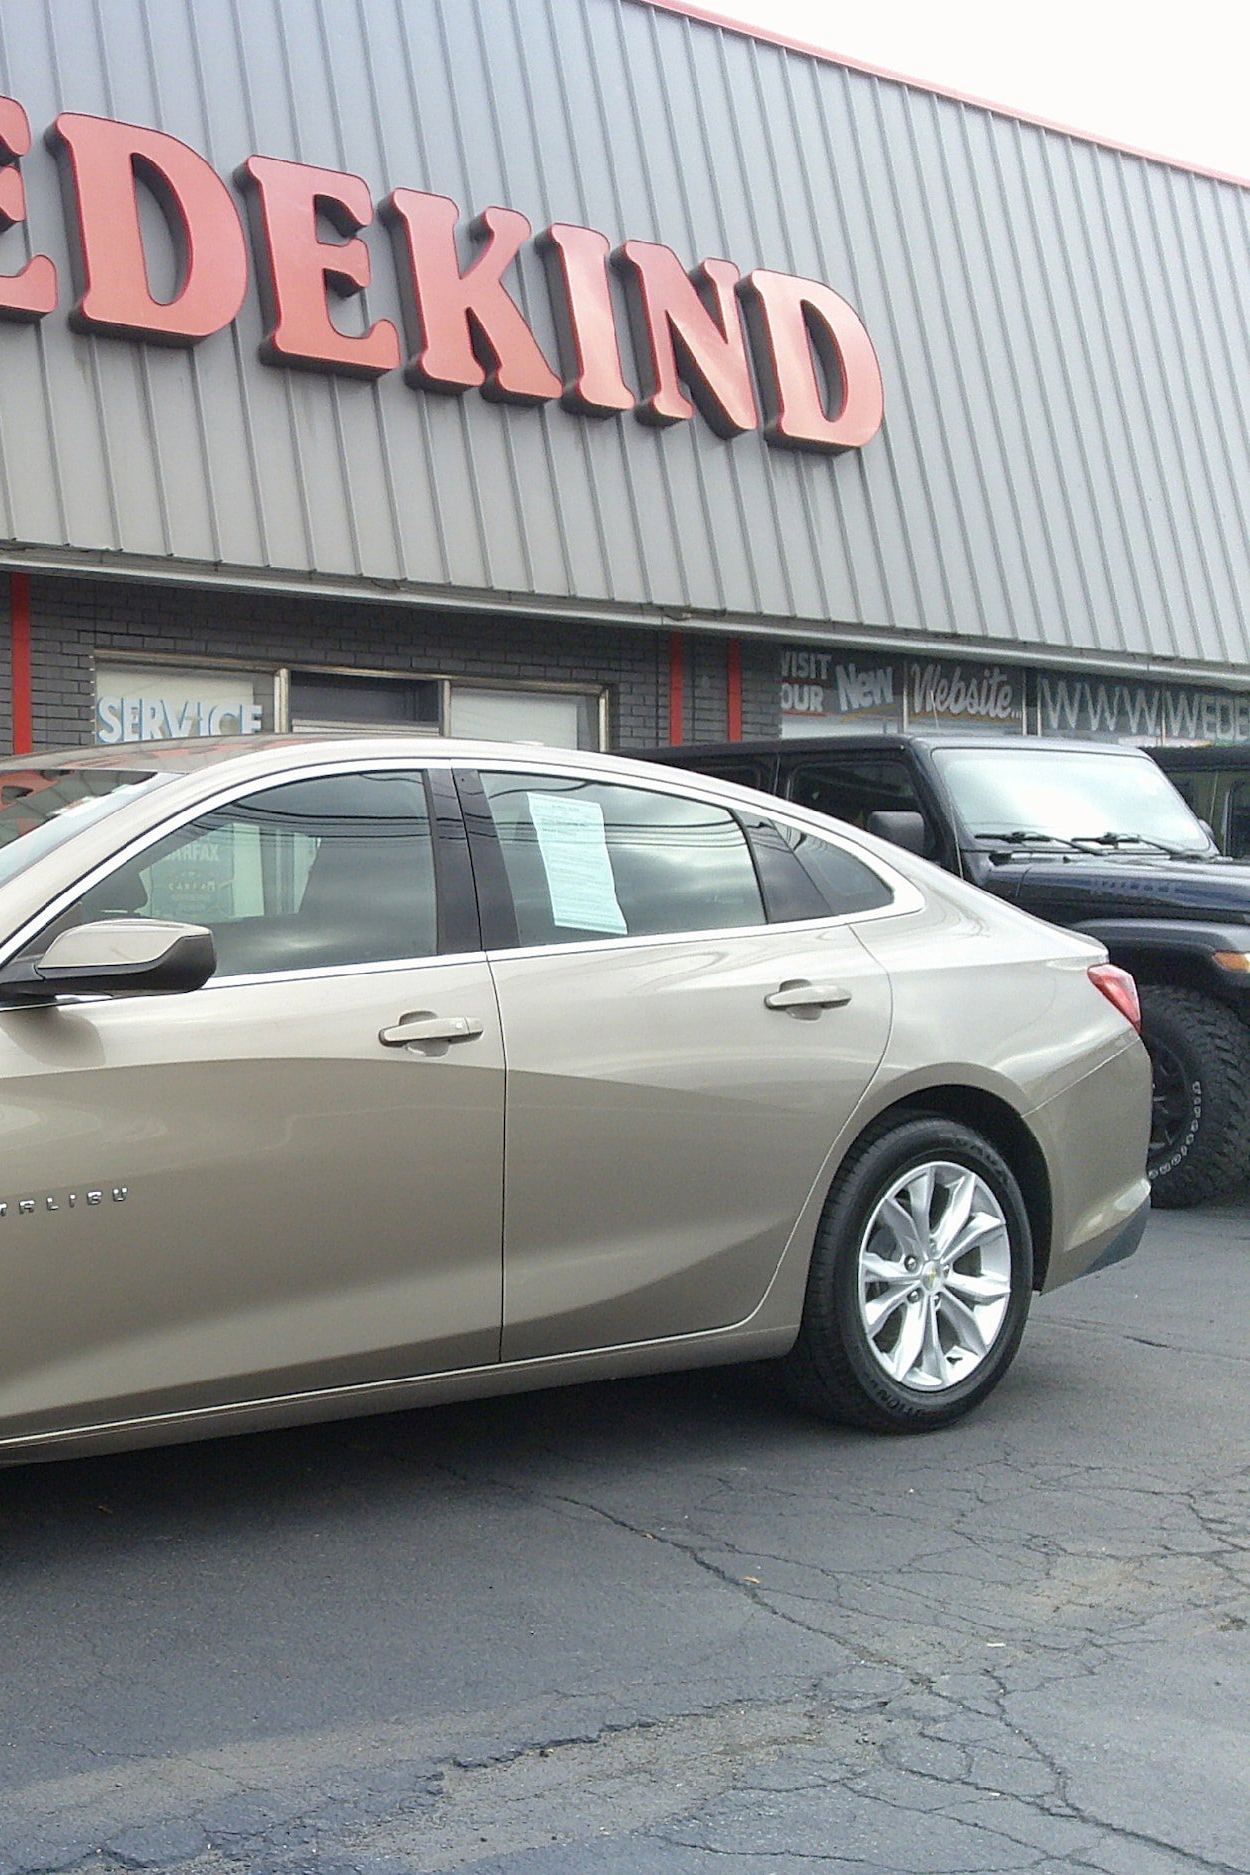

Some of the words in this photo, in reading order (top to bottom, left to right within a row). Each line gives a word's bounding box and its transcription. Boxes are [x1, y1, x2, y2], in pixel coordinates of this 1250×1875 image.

[781, 651, 831, 680] VISIT
[781, 683, 824, 712] OUR
[96, 696, 262, 744] SERVICE
